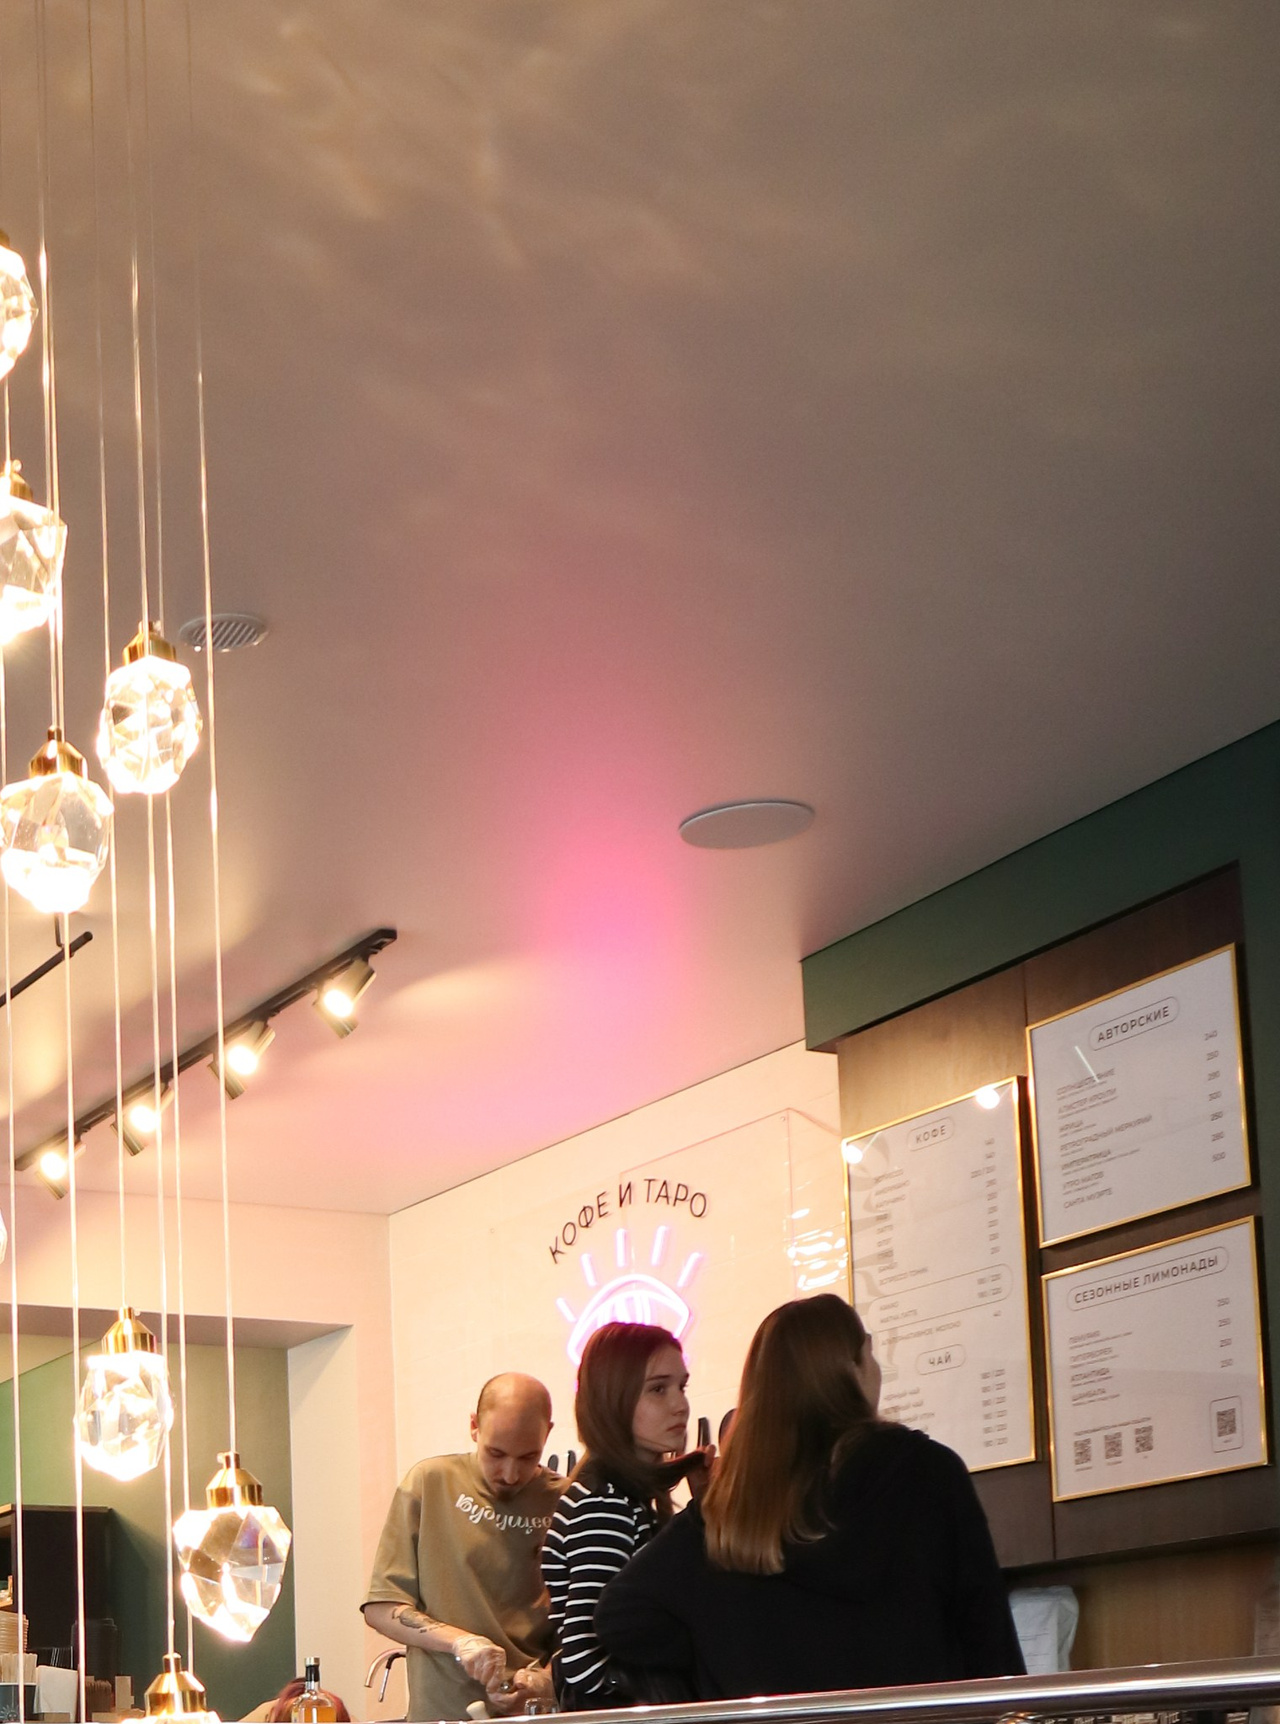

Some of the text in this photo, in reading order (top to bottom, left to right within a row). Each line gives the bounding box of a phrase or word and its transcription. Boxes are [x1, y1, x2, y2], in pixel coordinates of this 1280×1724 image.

[1098, 1006, 1170, 1043] АВТОРСКИЕ
[916, 1125, 946, 1144] КОФЕ
[549, 1178, 707, 1264] КОФЕ И ТАРО
[1074, 1255, 1218, 1304] СЕЗОННЫЕ ЛИМОНАДЫ
[928, 1351, 952, 1367] ЧАЙ
